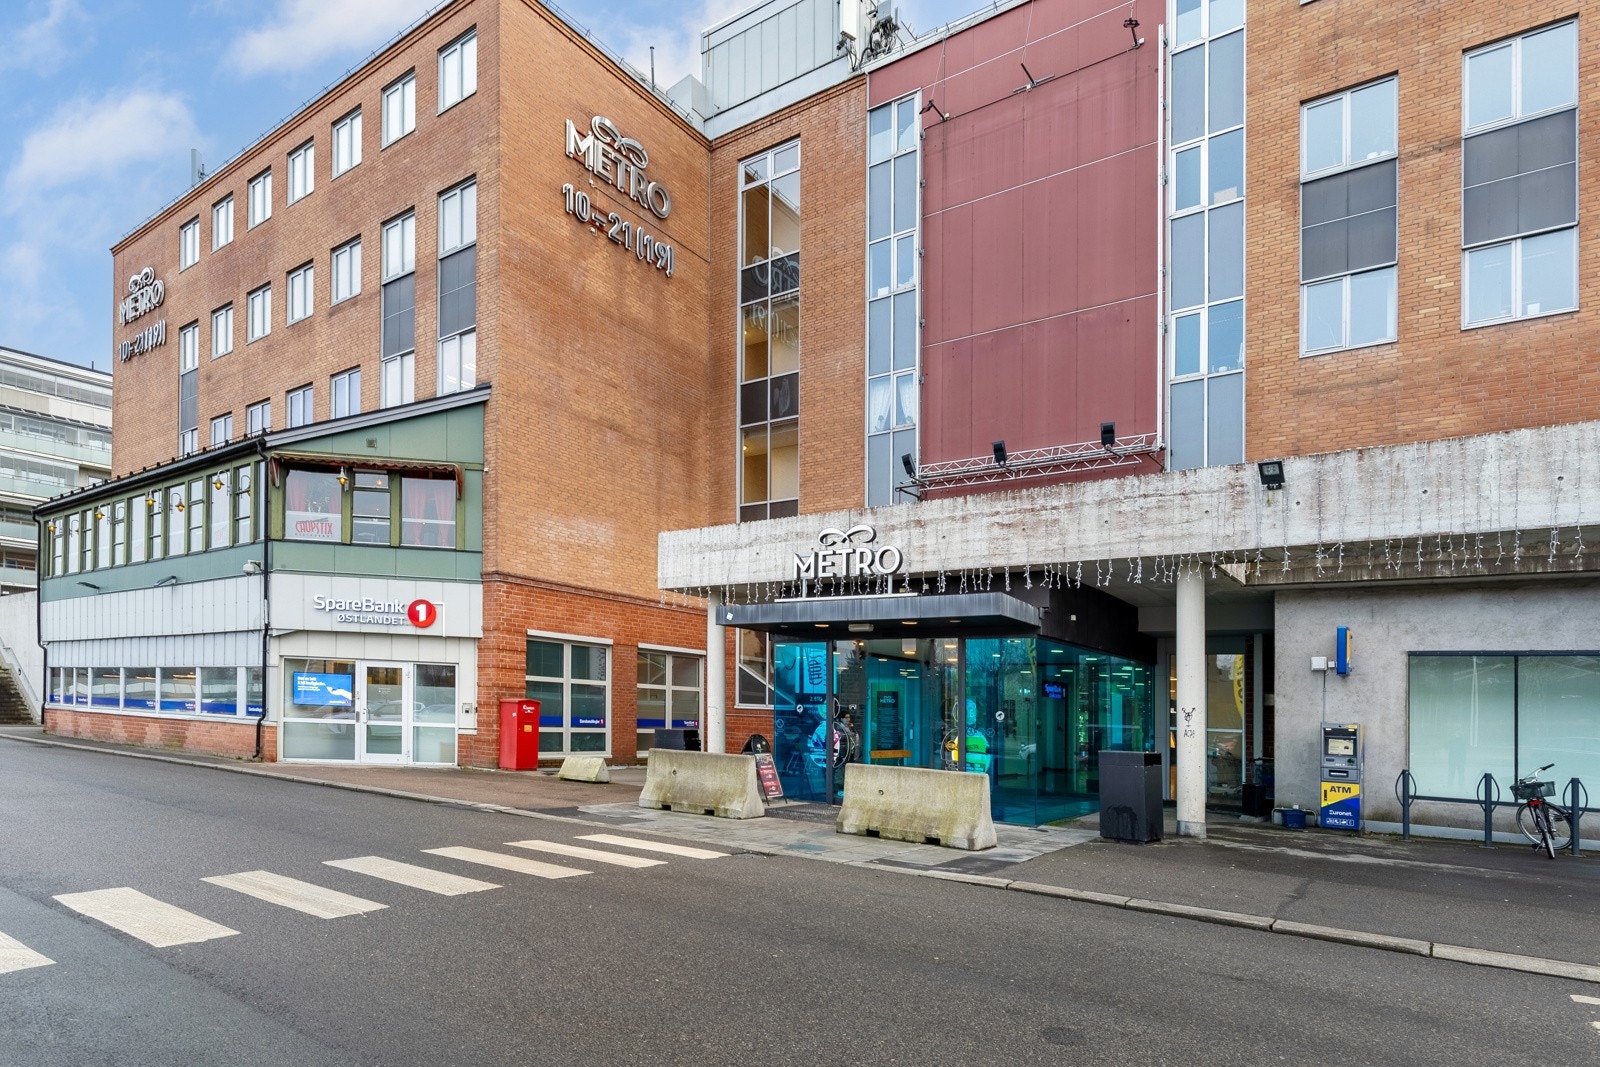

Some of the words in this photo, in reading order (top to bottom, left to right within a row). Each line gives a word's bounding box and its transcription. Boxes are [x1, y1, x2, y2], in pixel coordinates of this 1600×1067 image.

[565, 118, 672, 219] METRO
[119, 280, 165, 327] METRO
[295, 519, 333, 535] CHOPSTIX
[793, 545, 904, 579] METRO
[313, 594, 405, 614] SpareBank
[337, 613, 406, 625] ØSTLANDET
[1329, 786, 1352, 794] ATM
